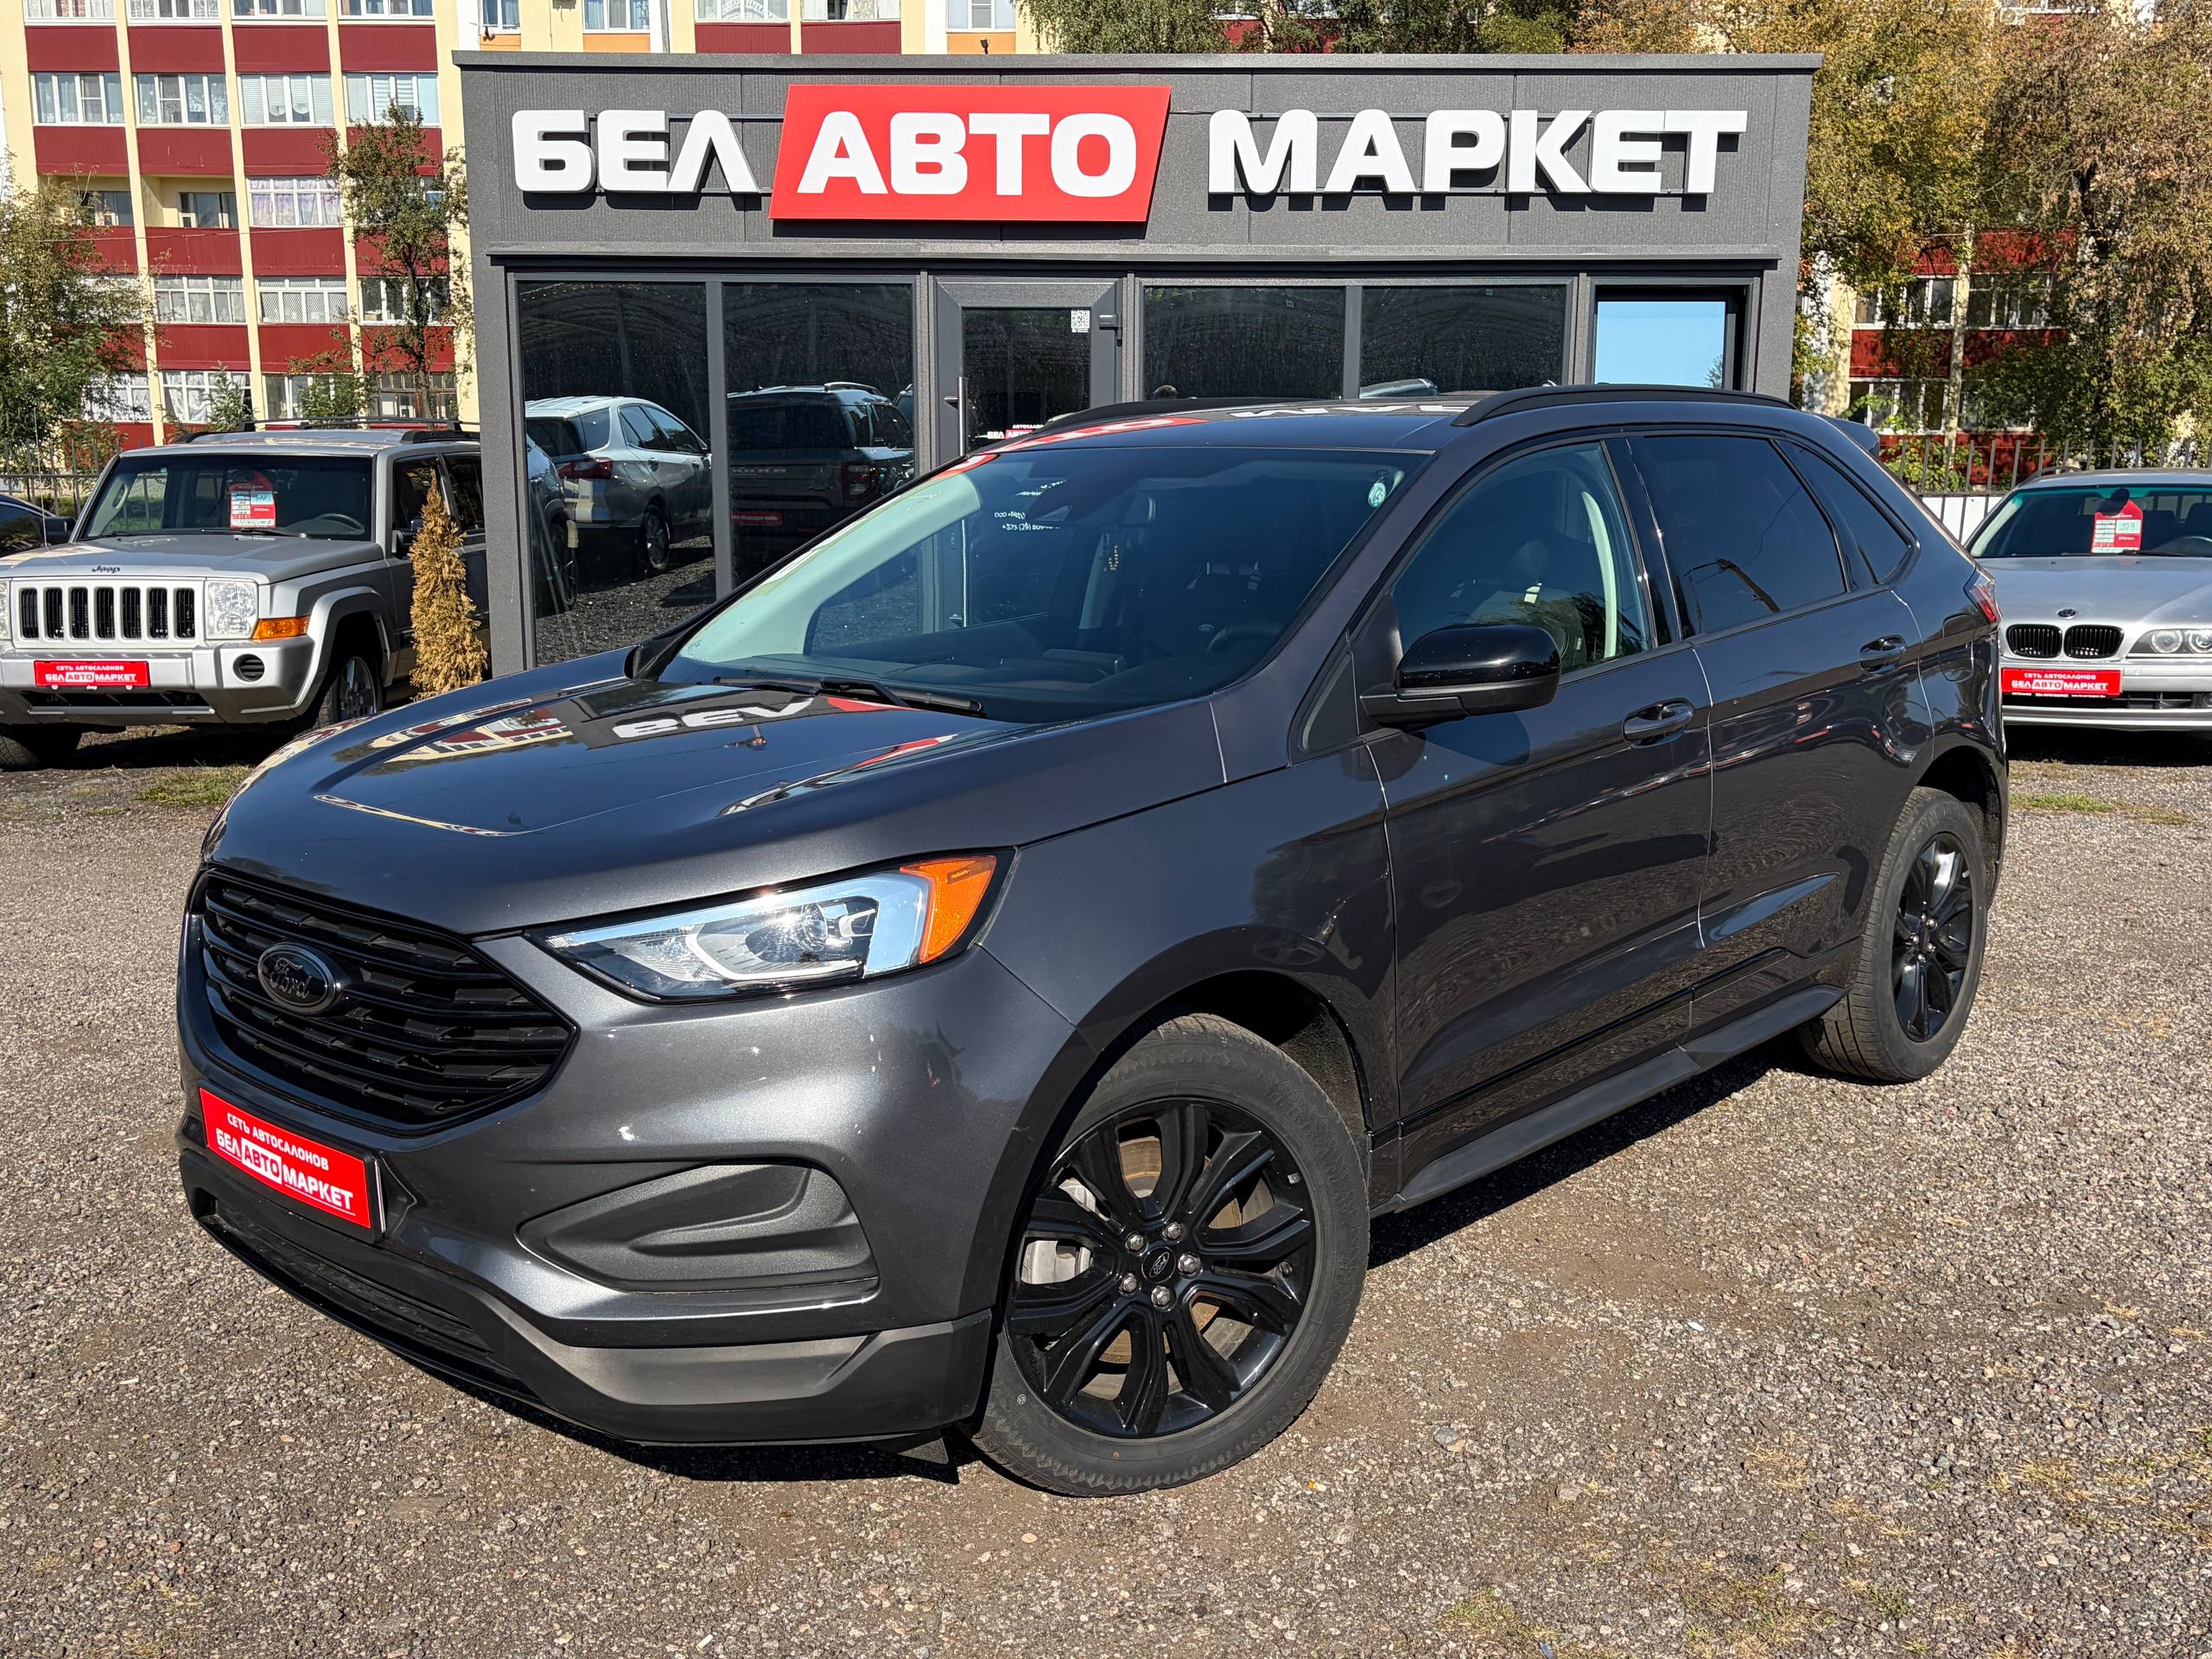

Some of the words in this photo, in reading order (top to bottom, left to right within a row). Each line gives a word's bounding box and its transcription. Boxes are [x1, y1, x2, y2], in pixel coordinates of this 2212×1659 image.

[512, 109, 761, 194] БЕЛ
[797, 110, 1137, 198] АВТО
[1208, 109, 1748, 195] МАРКЕТ
[45, 673, 65, 682] БЕЛ
[2012, 680, 2031, 689] БЕЛ
[2032, 681, 2062, 690] АВТО
[2063, 682, 2108, 690] МАРКЕТ
[270, 957, 312, 999] Ford
[226, 1112, 251, 1135] СЕТЬ
[252, 1126, 329, 1171] АВТОСАЛОНОВ
[216, 1128, 241, 1158] БЕЛ
[243, 1143, 281, 1178] АВТО
[283, 1164, 353, 1211] МАРКЕТ
